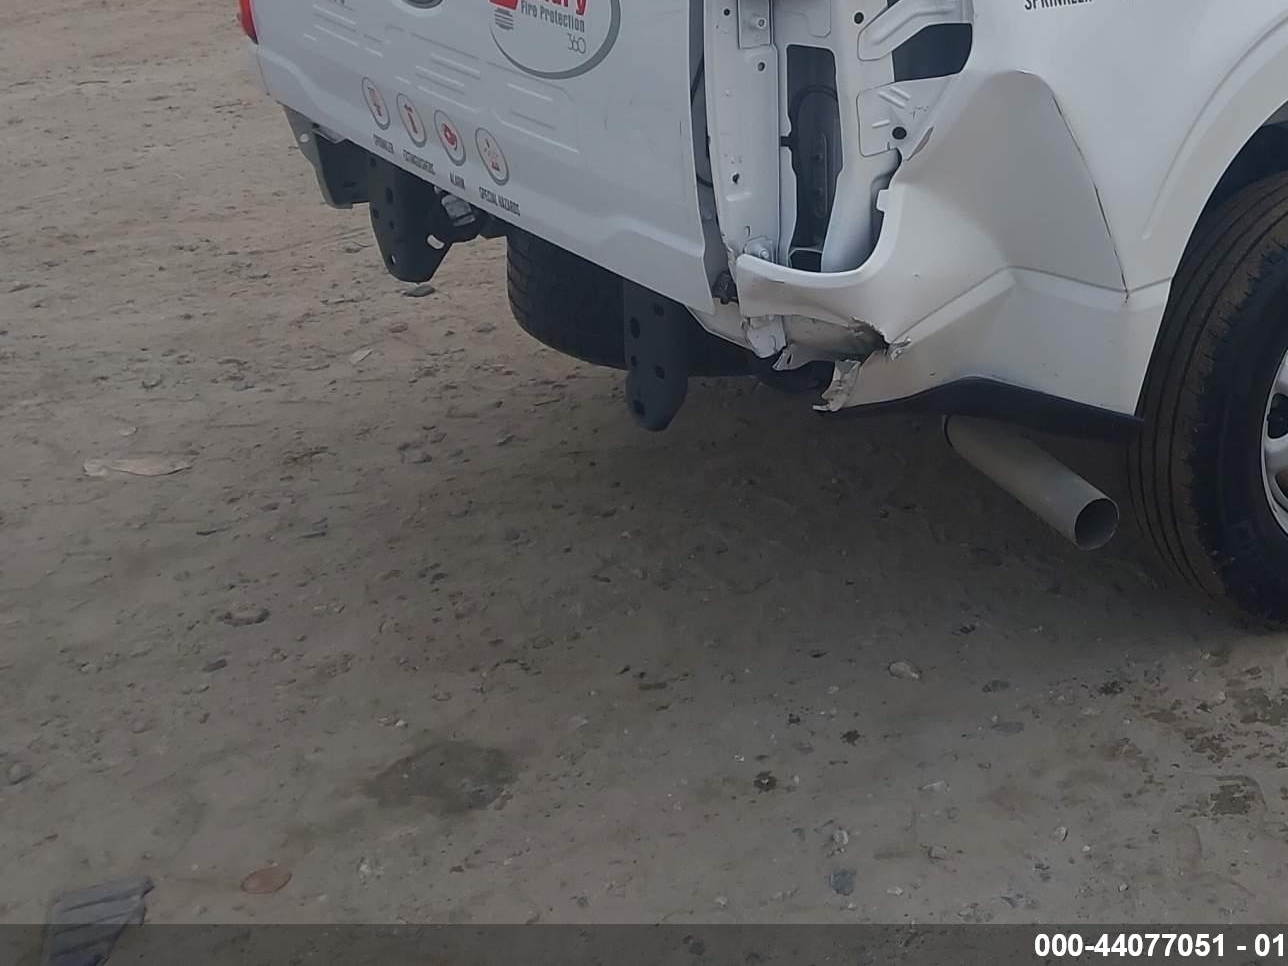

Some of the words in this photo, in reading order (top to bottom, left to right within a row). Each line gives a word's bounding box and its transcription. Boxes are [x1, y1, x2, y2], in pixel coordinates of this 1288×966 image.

[521, 0, 537, 18] Fire
[540, 6, 585, 33] Protection
[567, 33, 586, 54] 360
